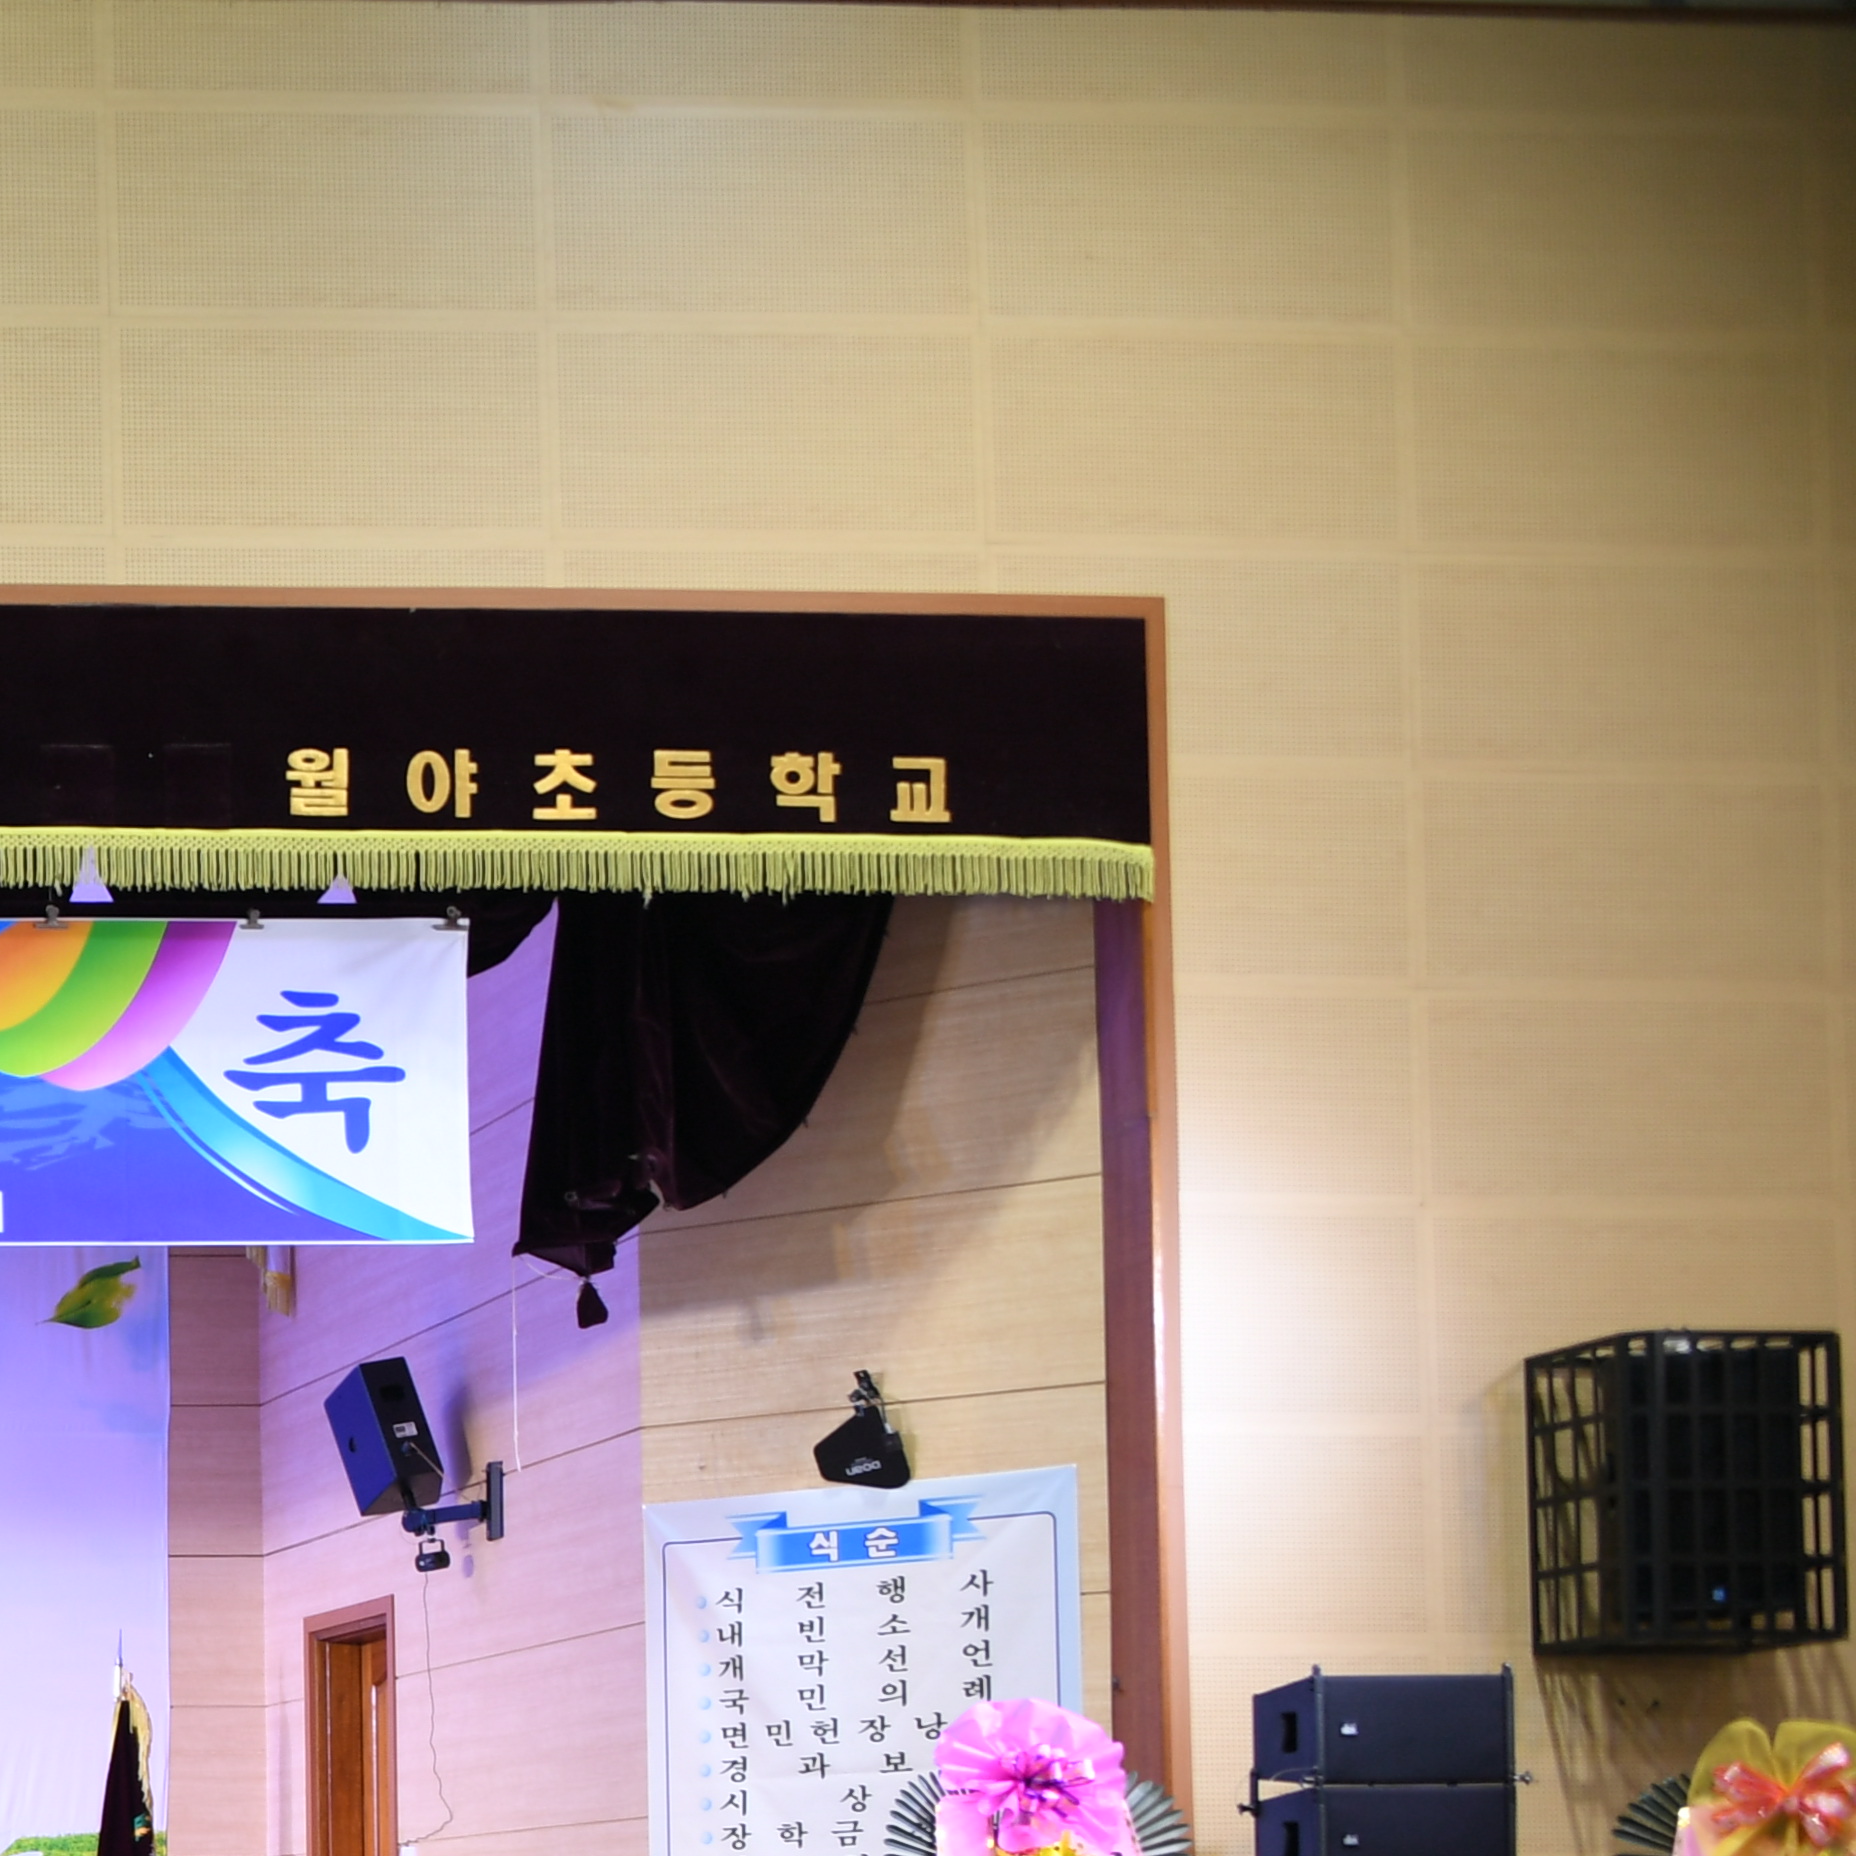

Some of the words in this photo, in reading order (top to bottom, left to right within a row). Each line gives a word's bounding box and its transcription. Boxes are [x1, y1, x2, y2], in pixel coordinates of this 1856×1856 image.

[285, 748, 952, 824] 월야초등학교
[223, 990, 406, 1156] 축
[809, 1526, 900, 1564] 식순
